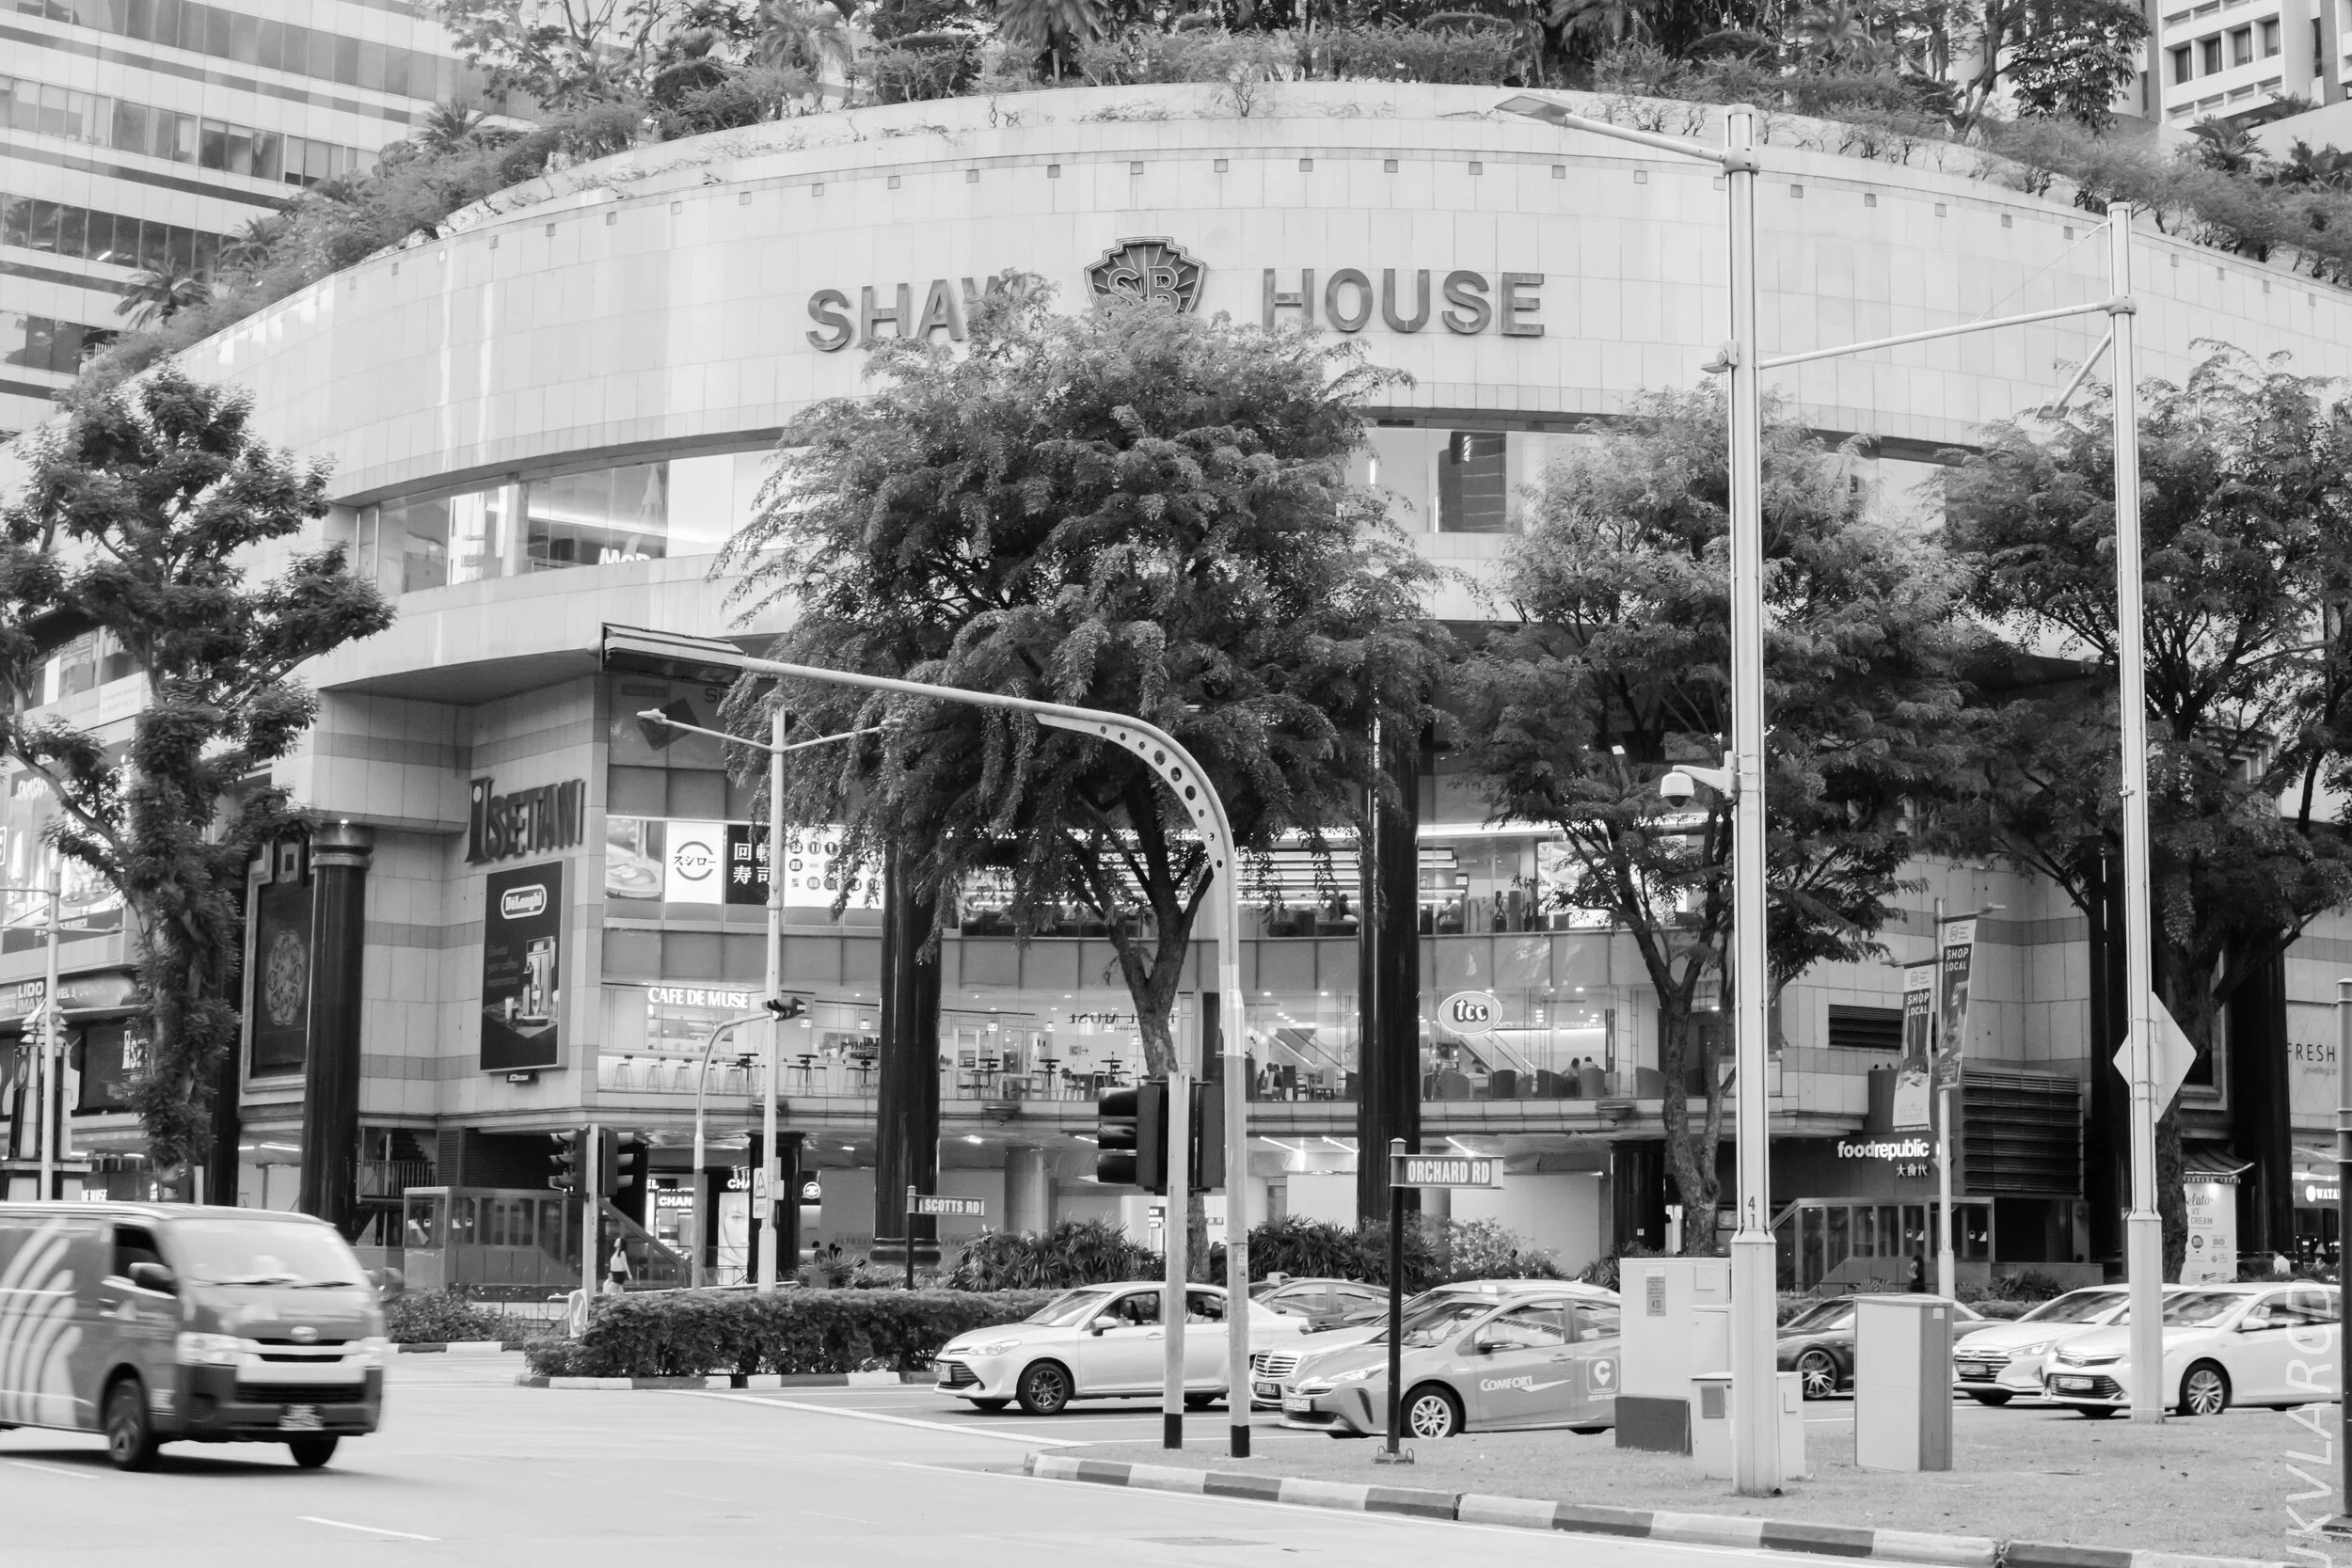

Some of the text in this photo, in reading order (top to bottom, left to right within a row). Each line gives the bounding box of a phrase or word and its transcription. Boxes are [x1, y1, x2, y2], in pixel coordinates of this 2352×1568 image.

[1263, 268, 1545, 336] HOUSE
[465, 777, 585, 864] ISETAN
[674, 855, 716, 866] スシロー
[1947, 947, 1969, 960] SHOP
[1945, 960, 1966, 972] LOCAL
[18, 981, 44, 998] LIDO
[648, 987, 749, 1008] CAFE DE MUSE
[1907, 991, 1930, 1006] SHOP
[1454, 999, 1488, 1022] tcc
[1906, 1005, 1928, 1017] LOCAL
[2287, 1042, 2335, 1062] FRESH
[1837, 1139, 1930, 1162] foodrepublic
[1407, 1160, 1490, 1183] ORCHARD RD
[659, 1196, 693, 1207] CHAN
[2316, 1188, 2340, 1199] WATA
[925, 1198, 980, 1213] SCOTTS RD
[1480, 1376, 1533, 1392] COMFORT
